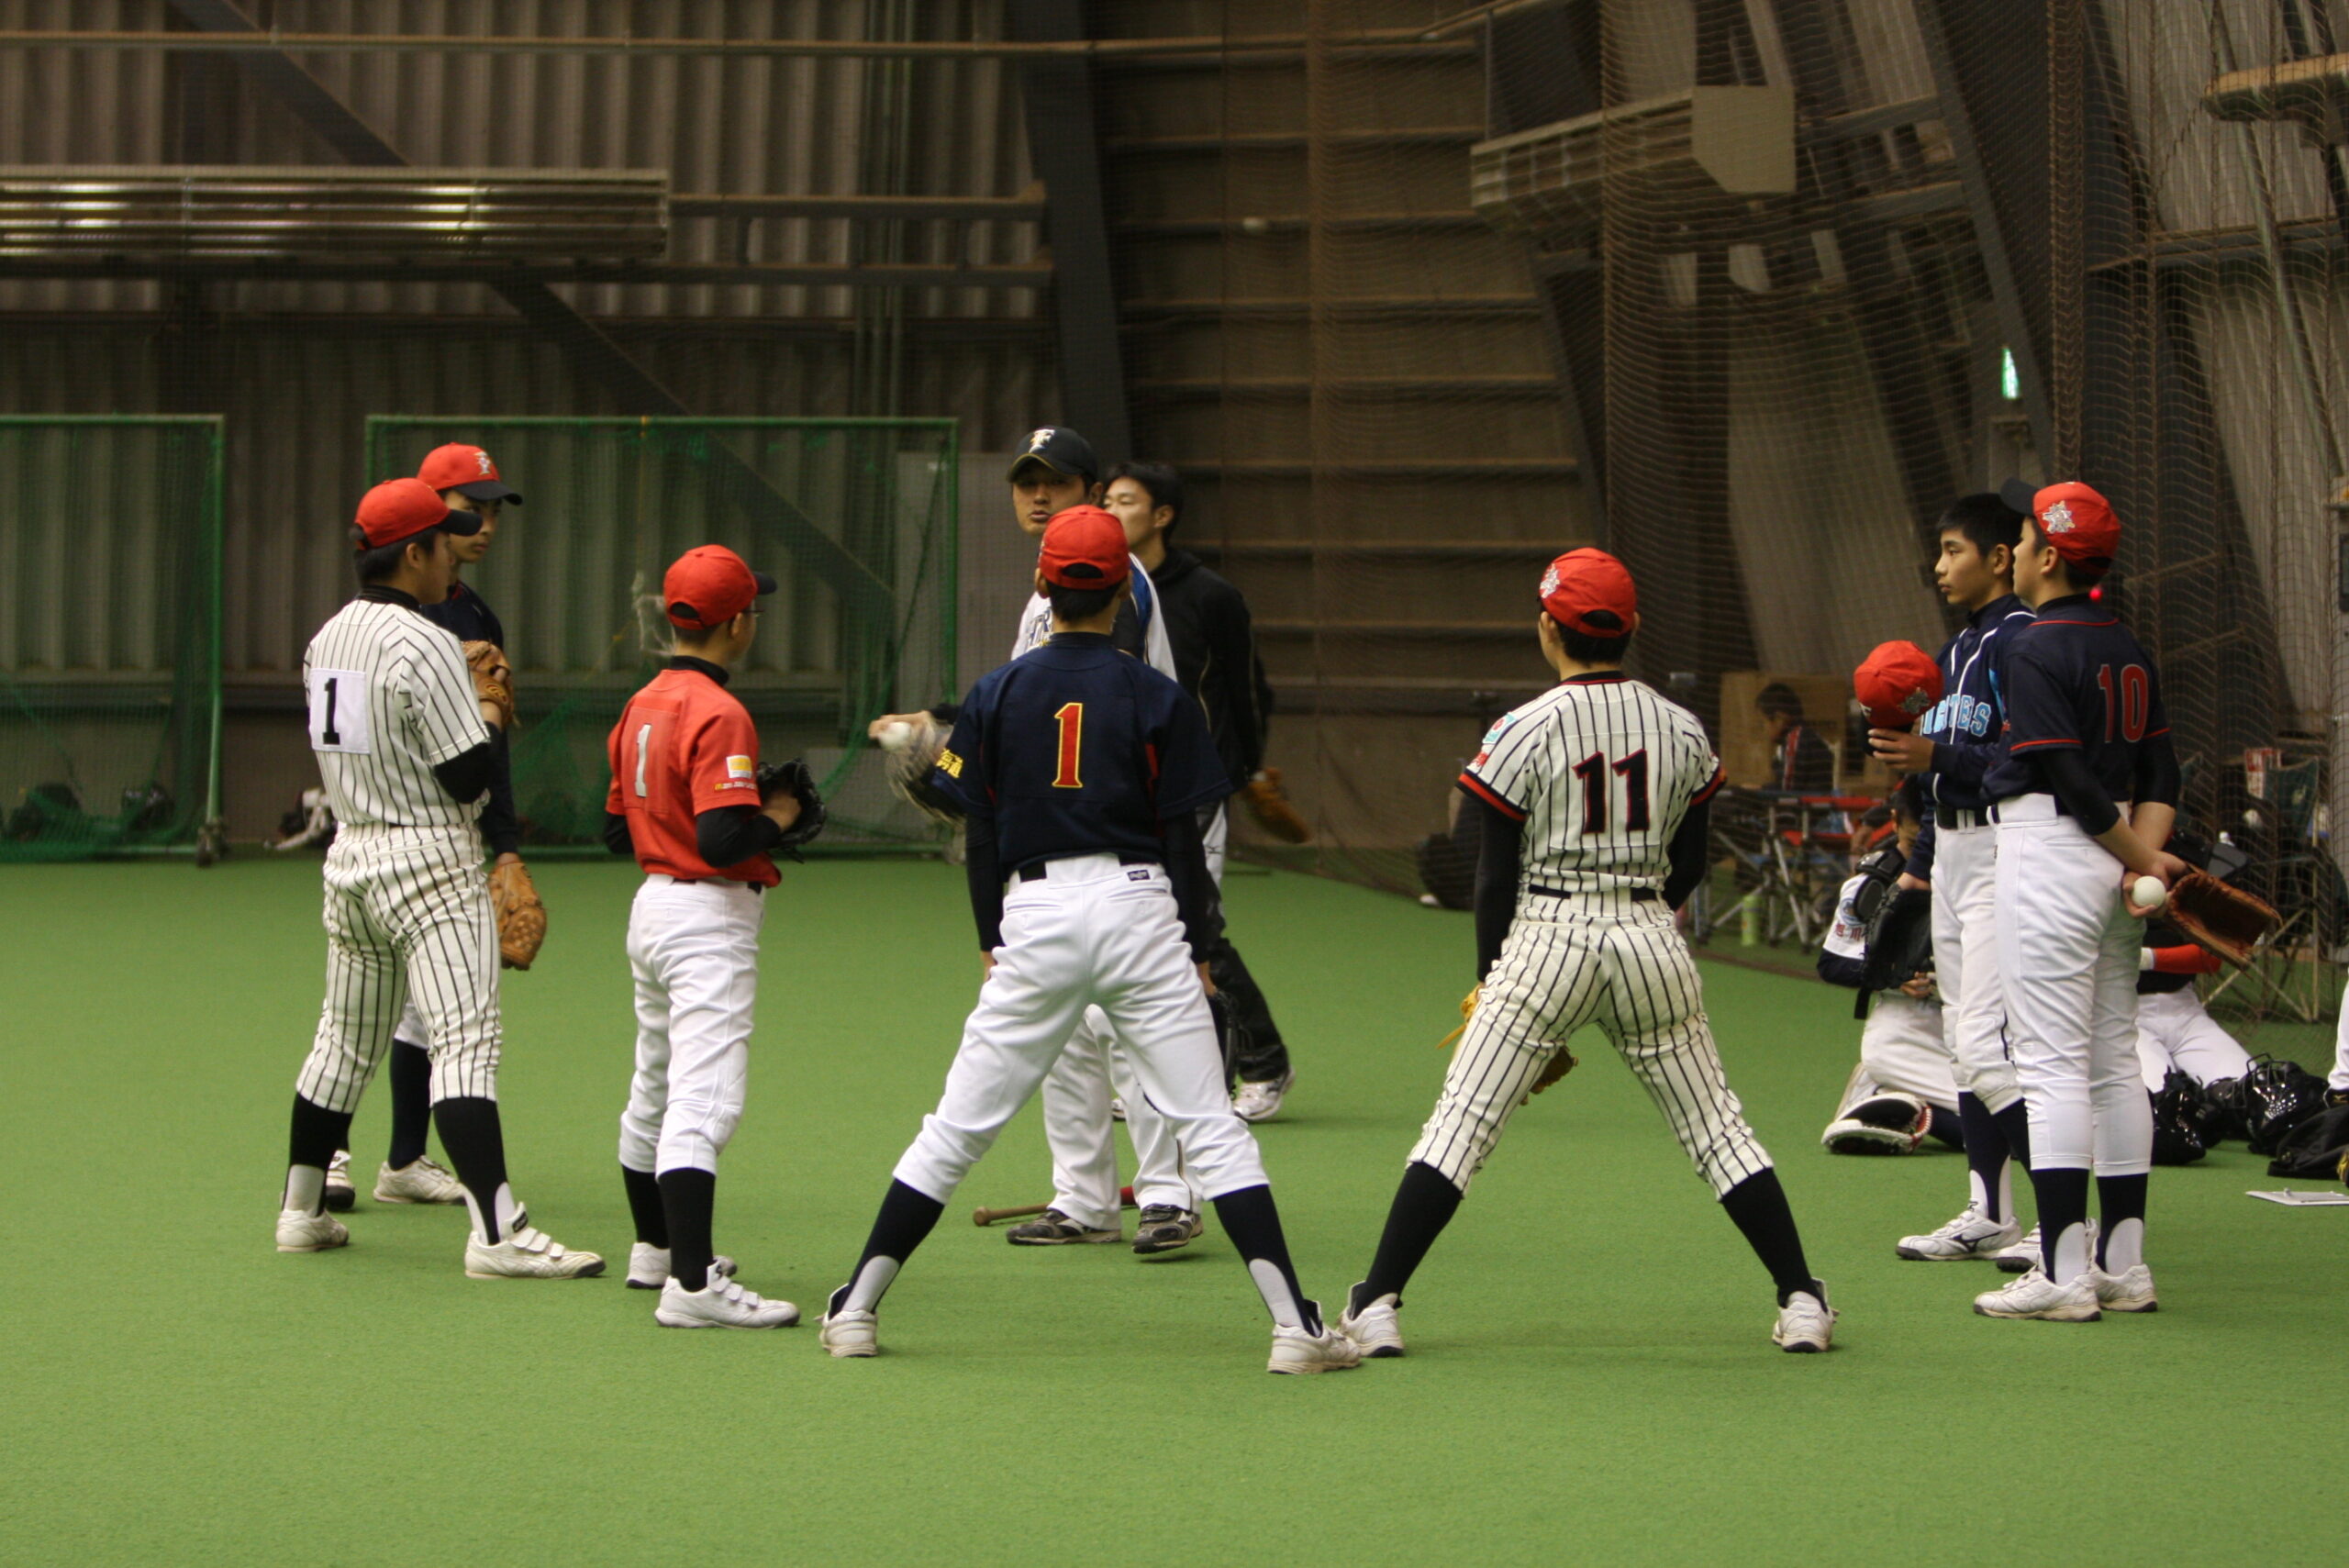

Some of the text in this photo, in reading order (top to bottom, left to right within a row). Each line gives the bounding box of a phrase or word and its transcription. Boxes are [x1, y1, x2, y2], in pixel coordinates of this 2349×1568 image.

[322, 677, 341, 746] 1
[2097, 663, 2149, 743] 10
[635, 723, 652, 798] 1
[1052, 702, 1084, 789] 1
[1572, 749, 1651, 835] 11
